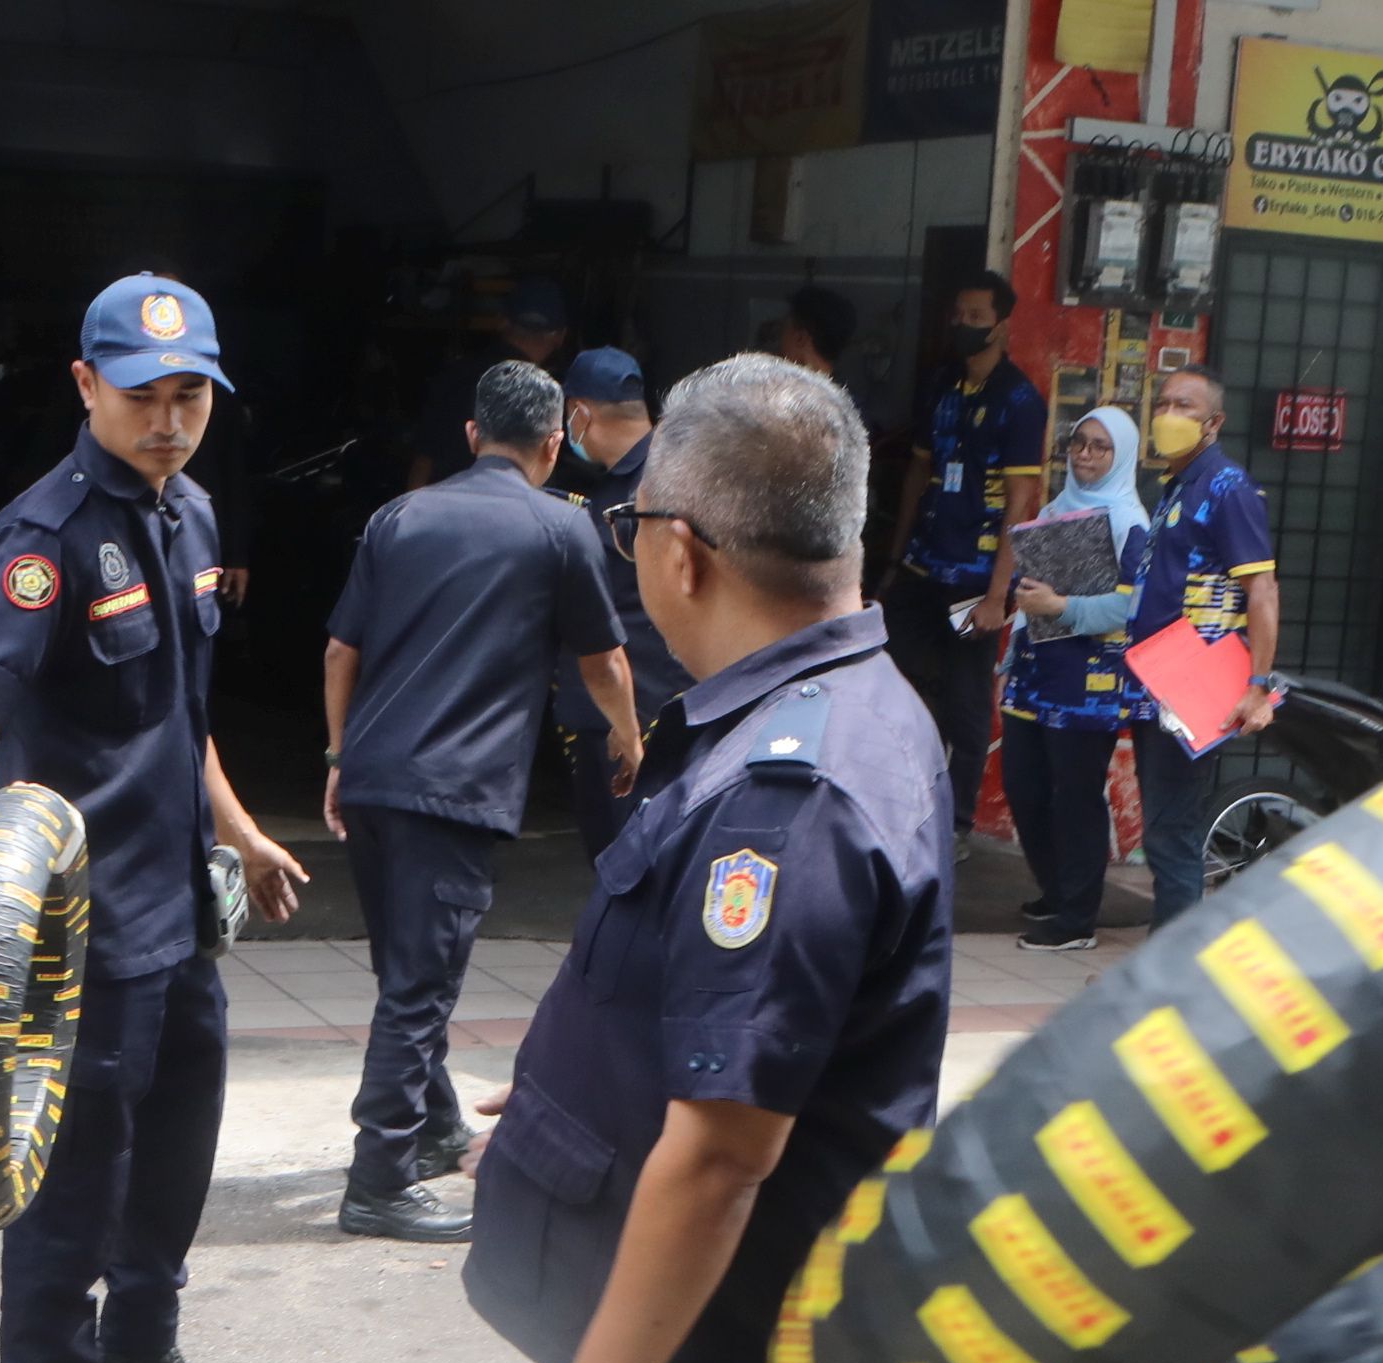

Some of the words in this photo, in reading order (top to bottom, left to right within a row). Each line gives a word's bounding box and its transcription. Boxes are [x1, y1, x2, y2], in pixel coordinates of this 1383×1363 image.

[1251, 140, 1367, 175] ERYTAKO
[1250, 174, 1276, 189] Tako
[1287, 180, 1318, 195] Pasta
[1328, 183, 1375, 200] Western
